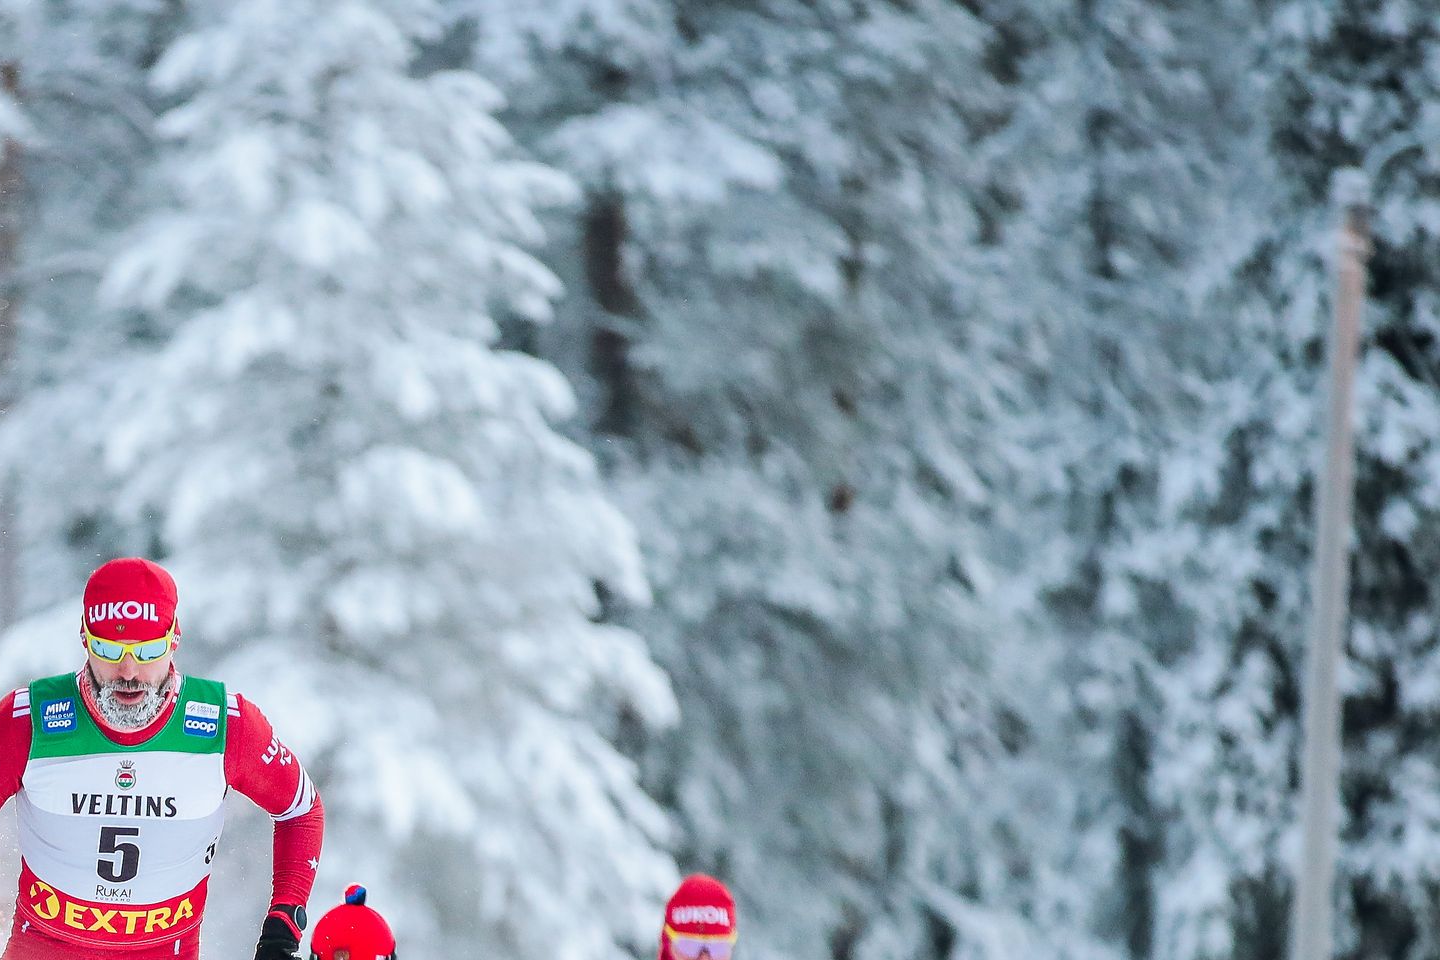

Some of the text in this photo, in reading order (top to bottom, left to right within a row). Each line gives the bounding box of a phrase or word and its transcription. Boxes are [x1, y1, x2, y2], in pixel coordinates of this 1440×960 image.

[89, 600, 158, 623] LUKOIL
[46, 701, 71, 715] MINI
[48, 719, 72, 728] coop
[185, 719, 216, 733] coop
[72, 793, 177, 817] VELTINS
[96, 826, 140, 883] 5
[64, 897, 194, 935] EXTRA
